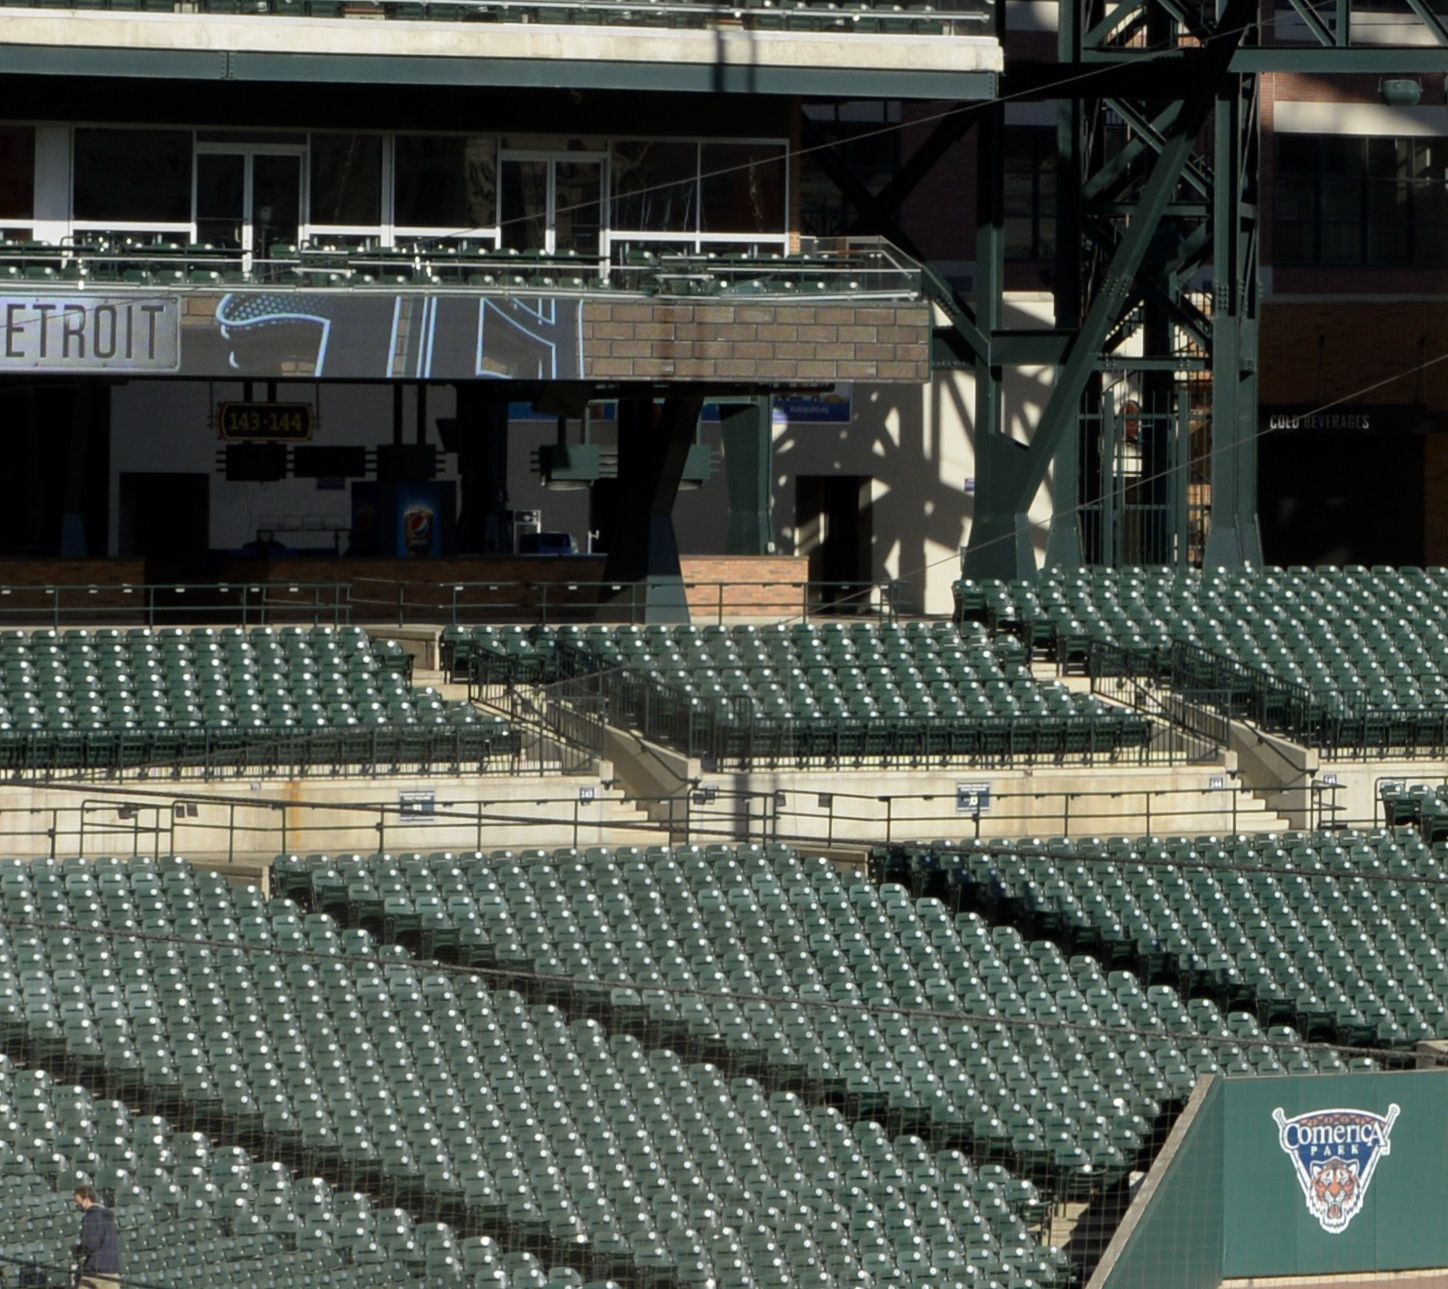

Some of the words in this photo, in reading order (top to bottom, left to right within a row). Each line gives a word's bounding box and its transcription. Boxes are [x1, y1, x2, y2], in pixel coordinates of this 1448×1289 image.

[1269, 414, 1300, 430] COLD
[1303, 414, 1370, 430] BEVERAGES
[1311, 1144, 1360, 1156] PARK
